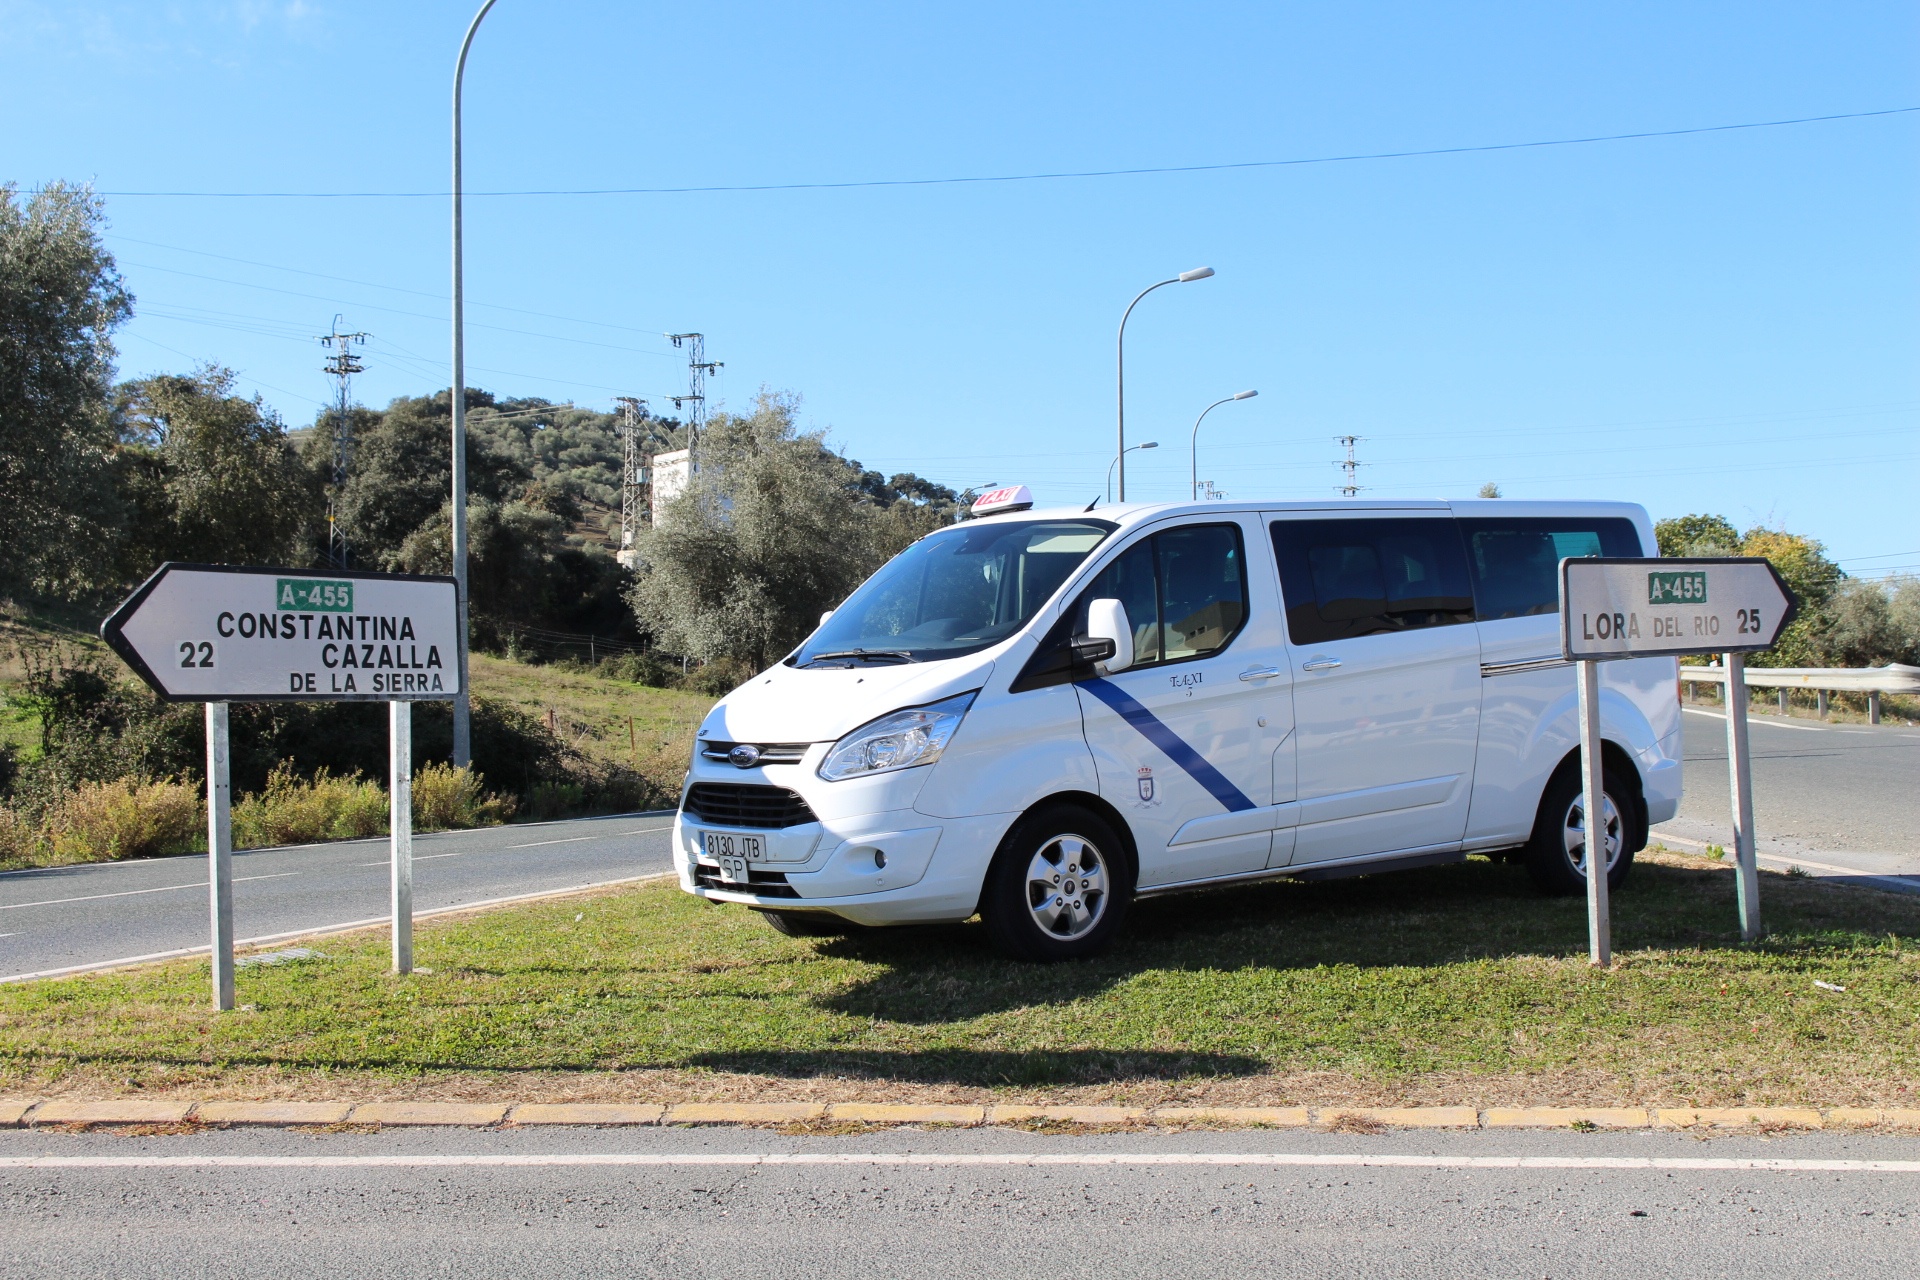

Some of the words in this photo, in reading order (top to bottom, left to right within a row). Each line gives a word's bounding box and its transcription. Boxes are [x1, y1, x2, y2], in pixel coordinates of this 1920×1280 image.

[975, 487, 1018, 506] TAXI
[281, 584, 349, 608] A-455
[1652, 577, 1703, 599] A-455
[217, 611, 415, 641] CONSTANTINA
[1582, 612, 1641, 640] LORA
[1654, 617, 1683, 637] DEL
[1694, 615, 1720, 635] RIO
[1736, 608, 1761, 634] 25
[179, 641, 214, 668] 22
[322, 643, 442, 669] CAZALLA
[290, 672, 316, 693] DE
[332, 673, 357, 693] LA
[372, 672, 444, 693] SIERRA
[1170, 672, 1203, 687] TAXI
[707, 834, 735, 856] 8130
[739, 837, 760, 858] JTB
[723, 858, 743, 880] SP
